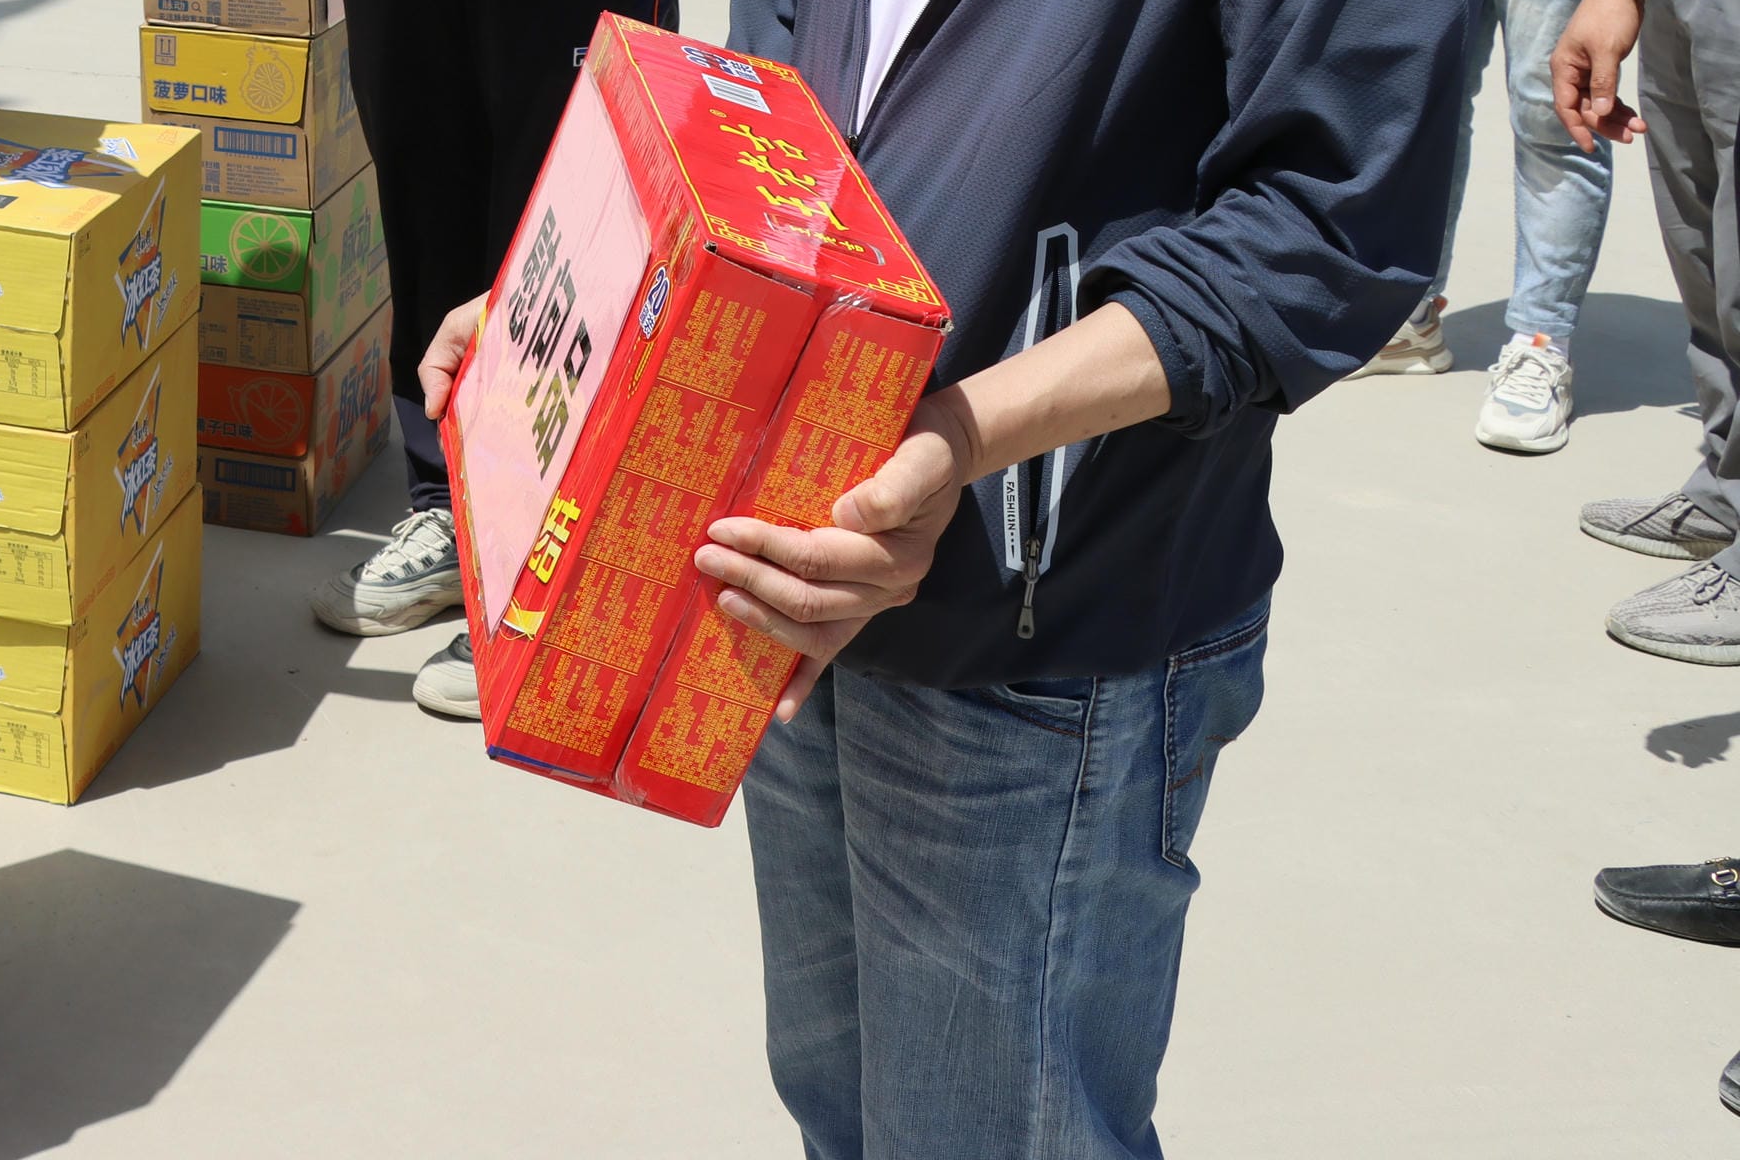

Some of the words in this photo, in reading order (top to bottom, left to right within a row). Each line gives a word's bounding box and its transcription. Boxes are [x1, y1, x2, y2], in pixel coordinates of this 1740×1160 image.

[153, 79, 228, 105] 菠萝口味
[719, 124, 849, 230] 王老吉
[789, 225, 865, 253] 王老吉
[648, 265, 670, 317] 20
[508, 204, 592, 480] 慰问品
